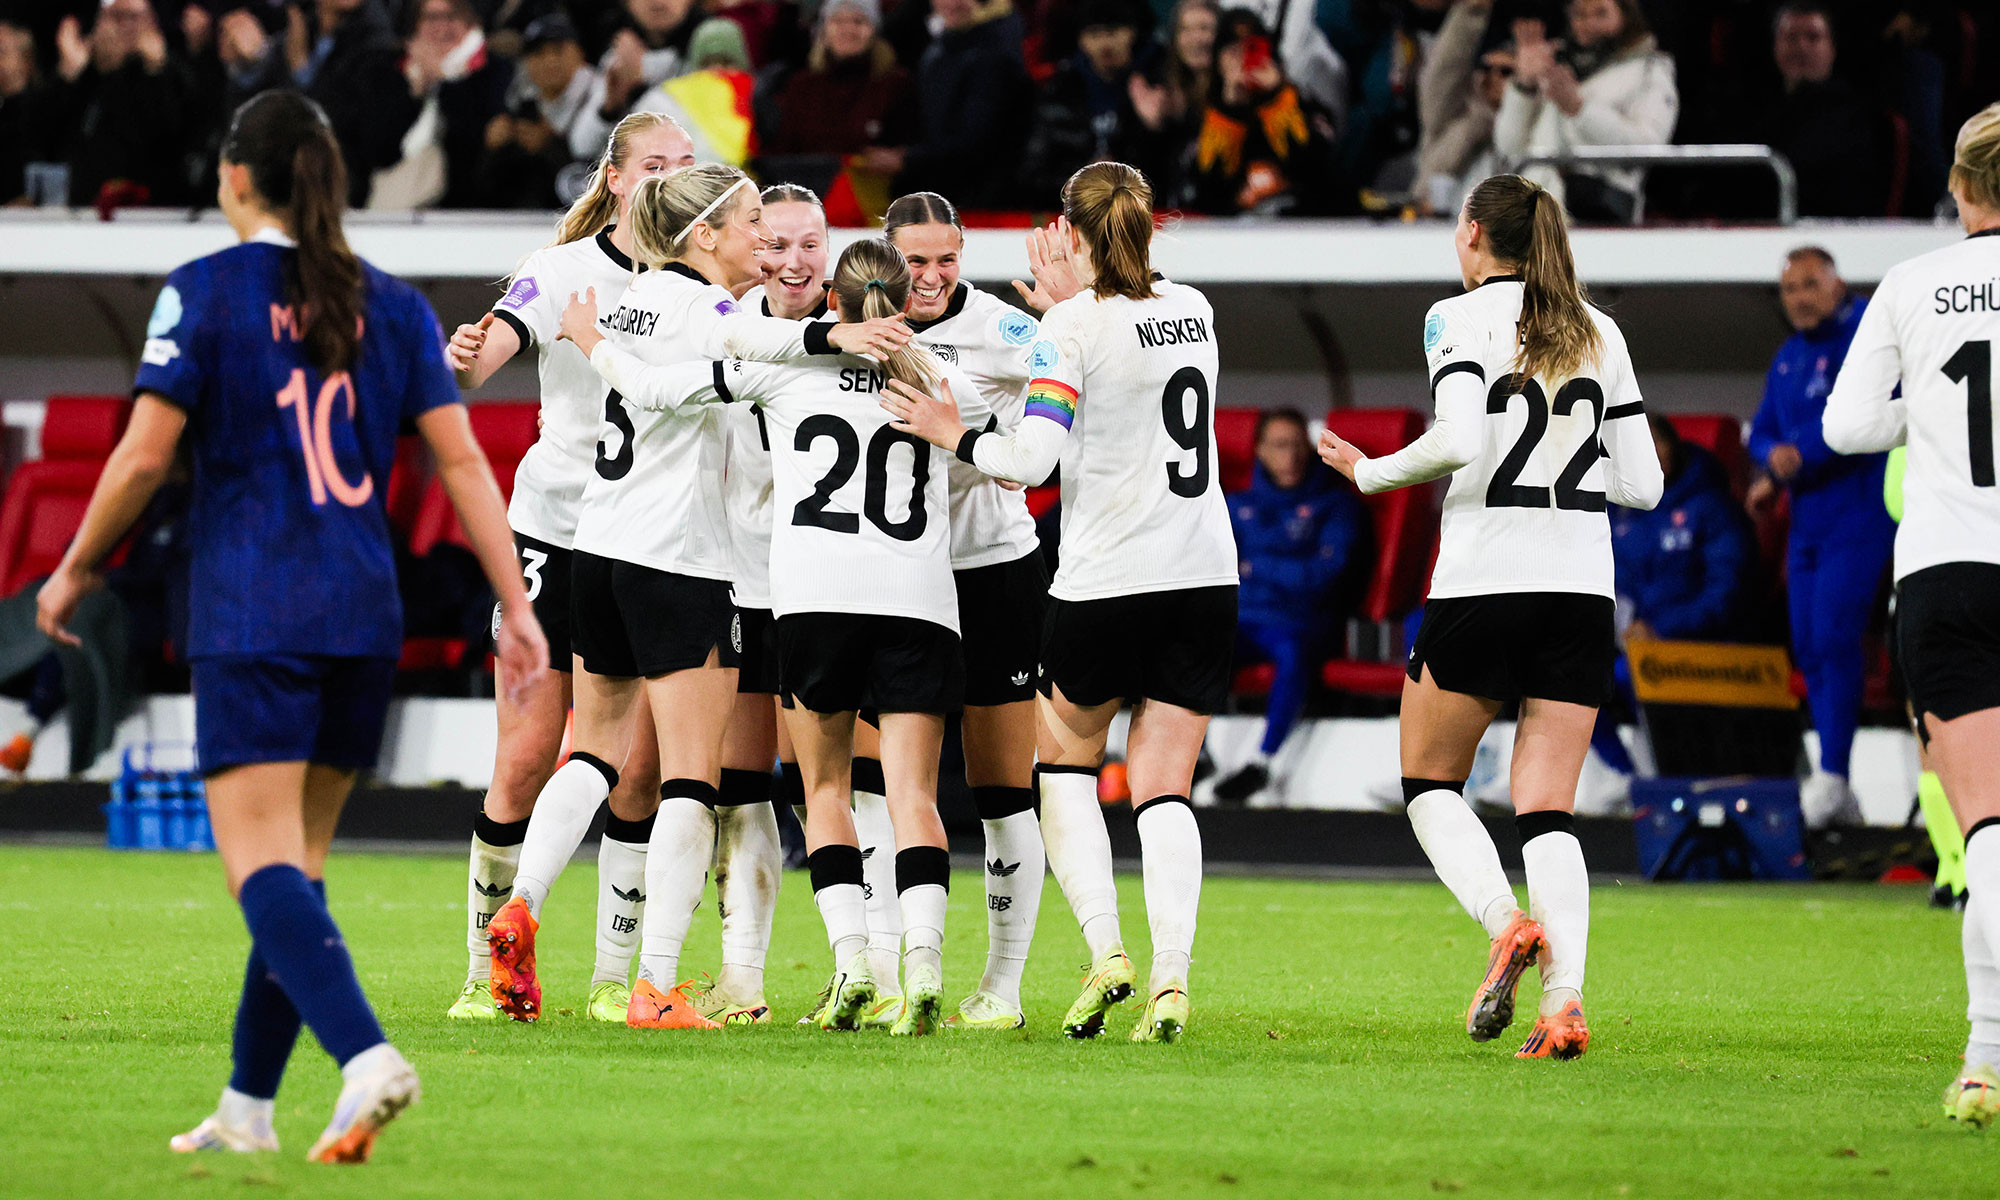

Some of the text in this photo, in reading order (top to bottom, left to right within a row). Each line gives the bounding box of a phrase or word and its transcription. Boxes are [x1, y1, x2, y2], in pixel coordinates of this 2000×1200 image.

[1135, 317, 1208, 348] NÜSKEN
[1935, 277, 2000, 315] SCHÜ
[276, 368, 374, 507] 10
[838, 367, 891, 394] SEN
[1162, 366, 1210, 499] 9
[1484, 372, 1607, 514] 22
[791, 413, 932, 542] 20
